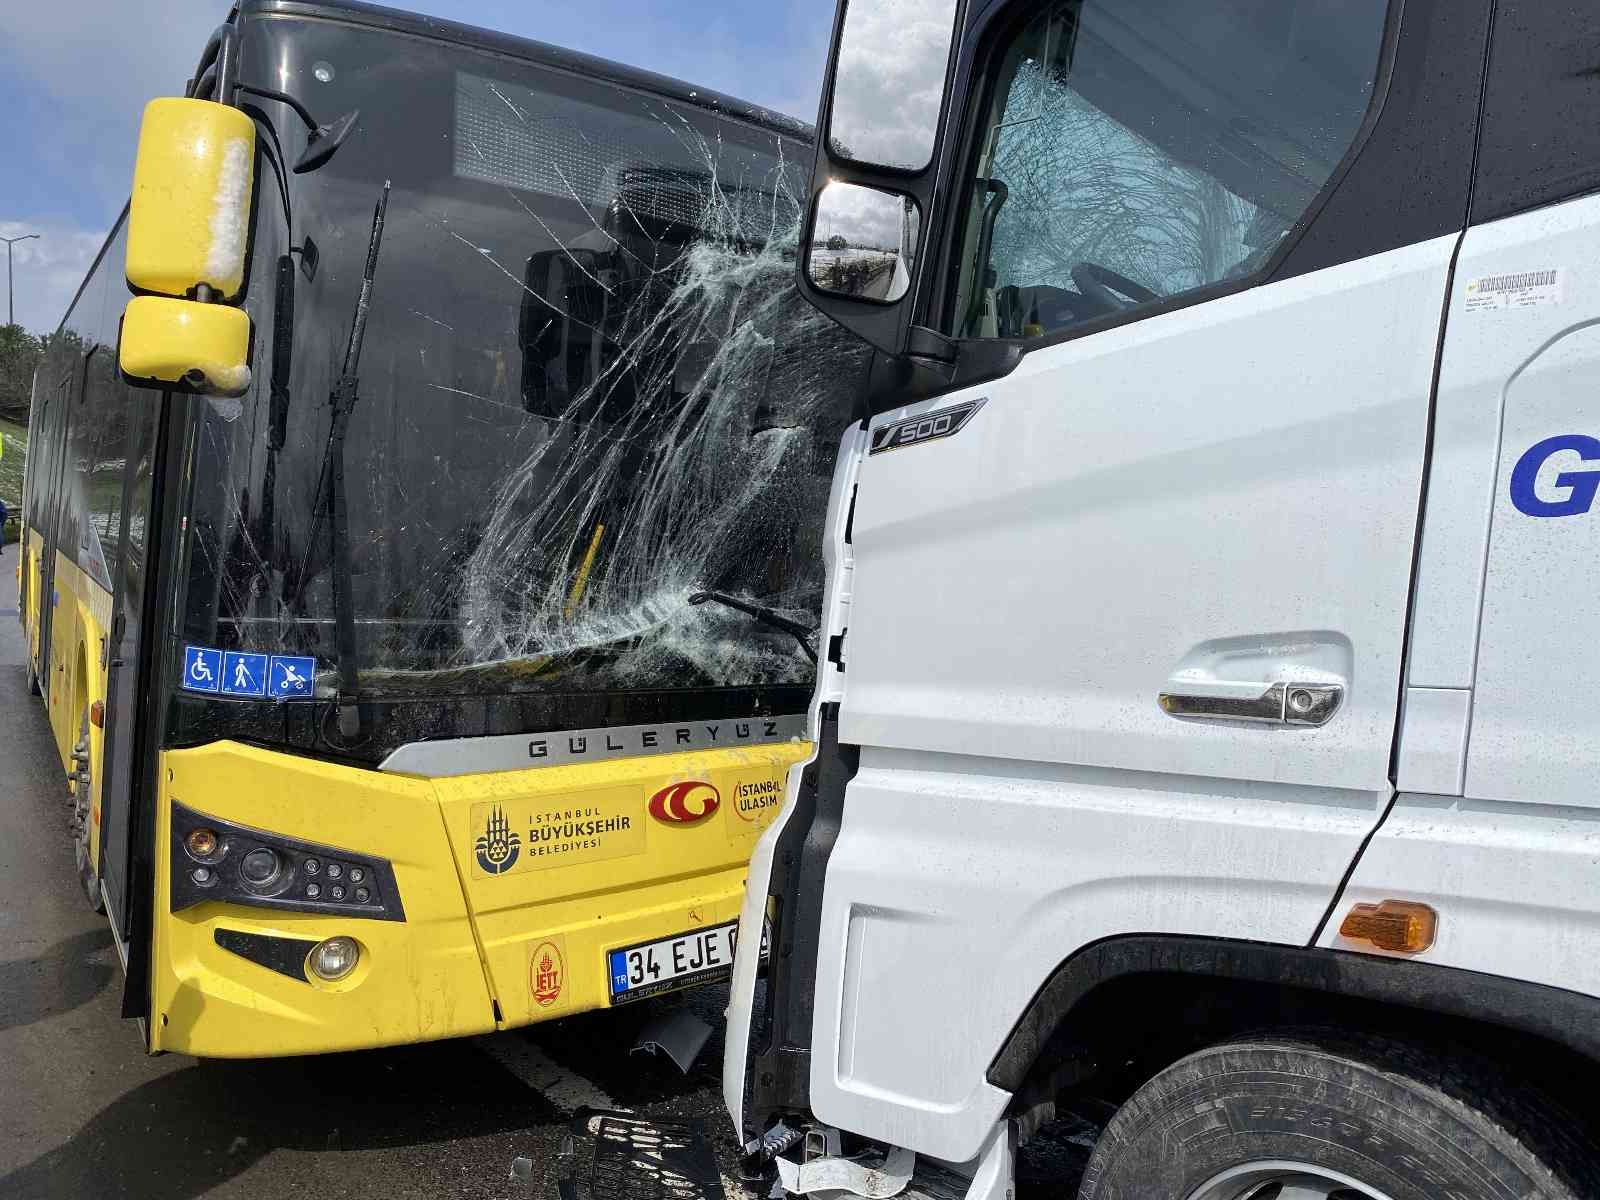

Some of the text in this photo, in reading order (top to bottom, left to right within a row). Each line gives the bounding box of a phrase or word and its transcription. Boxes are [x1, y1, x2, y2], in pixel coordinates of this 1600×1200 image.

[529, 722, 777, 757] GÜLERYÜZ
[529, 815, 631, 843] BÜYÜKŞEHİR
[628, 947, 661, 985] 34
[672, 932, 720, 974] EJE
[615, 974, 627, 985] TR
